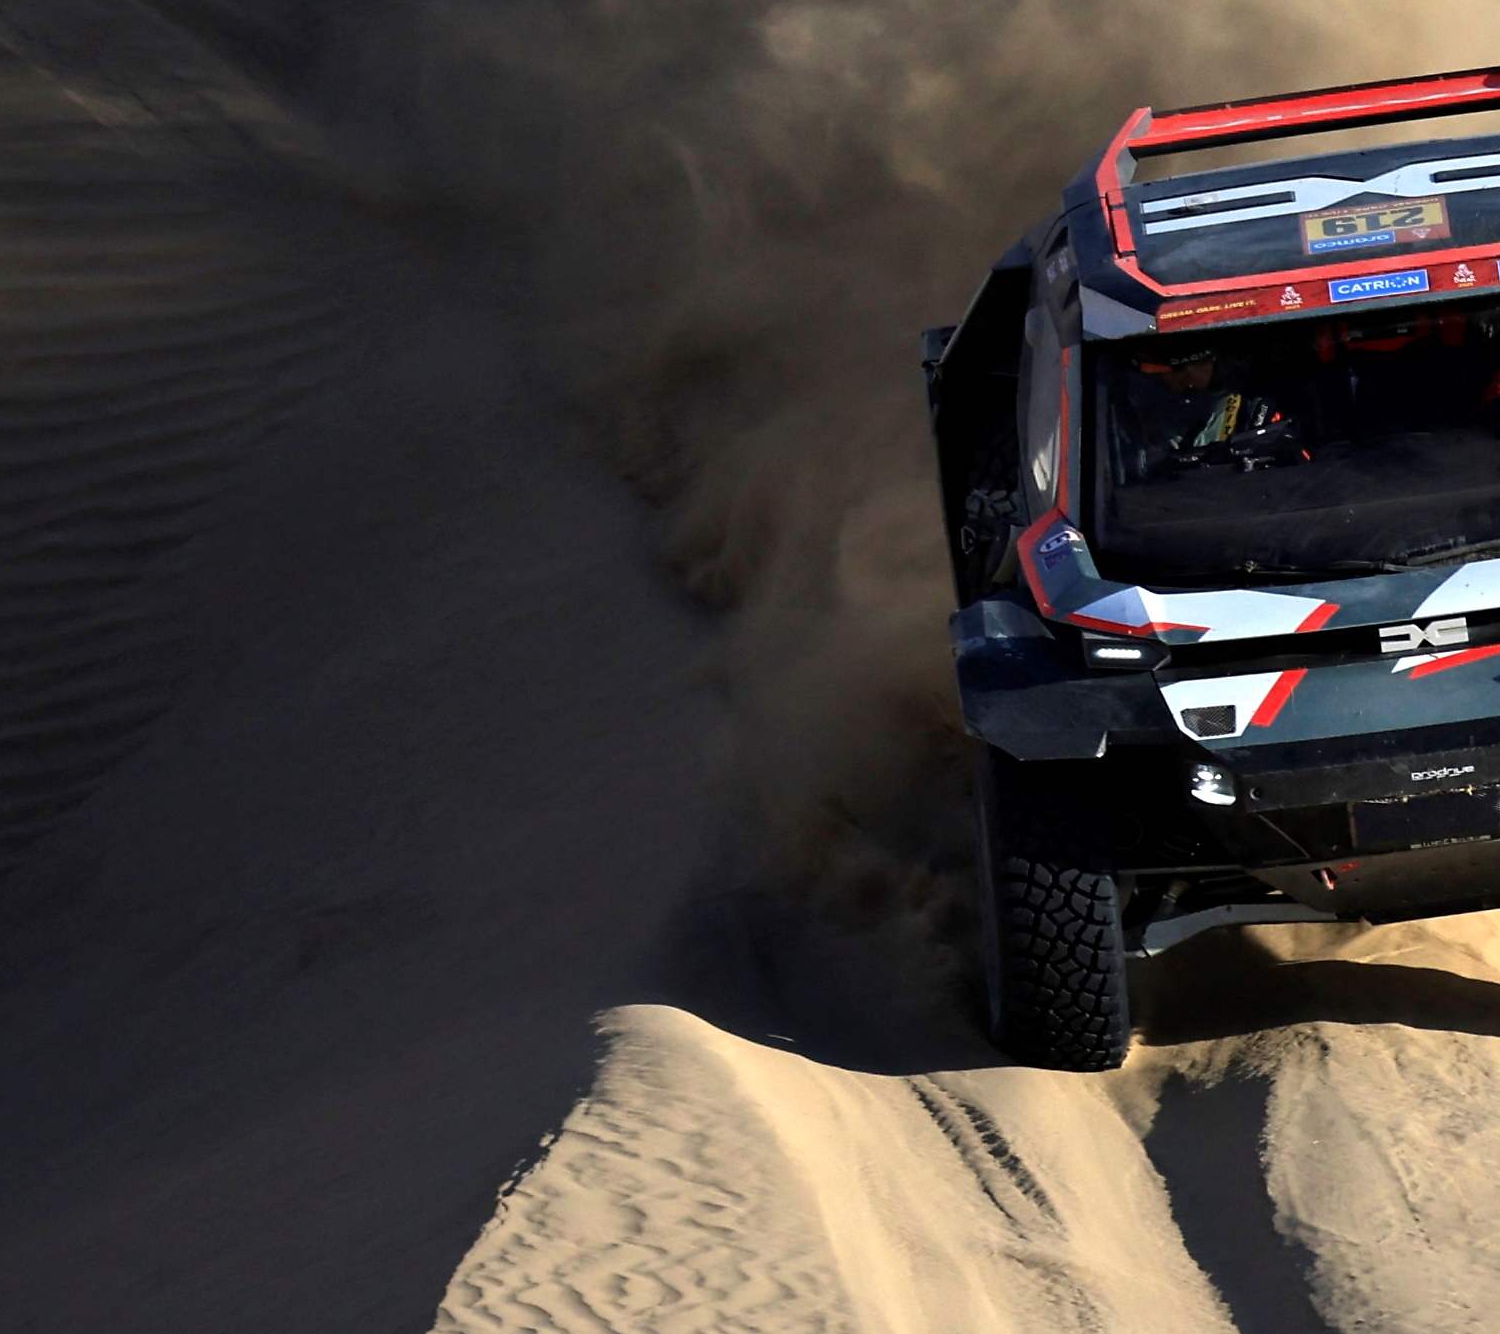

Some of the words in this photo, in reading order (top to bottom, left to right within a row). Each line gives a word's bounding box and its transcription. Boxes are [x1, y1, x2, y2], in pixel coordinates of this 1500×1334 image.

[1321, 206, 1425, 236] 219
[1313, 235, 1389, 249] aramco
[1411, 765, 1475, 781] prodrive
